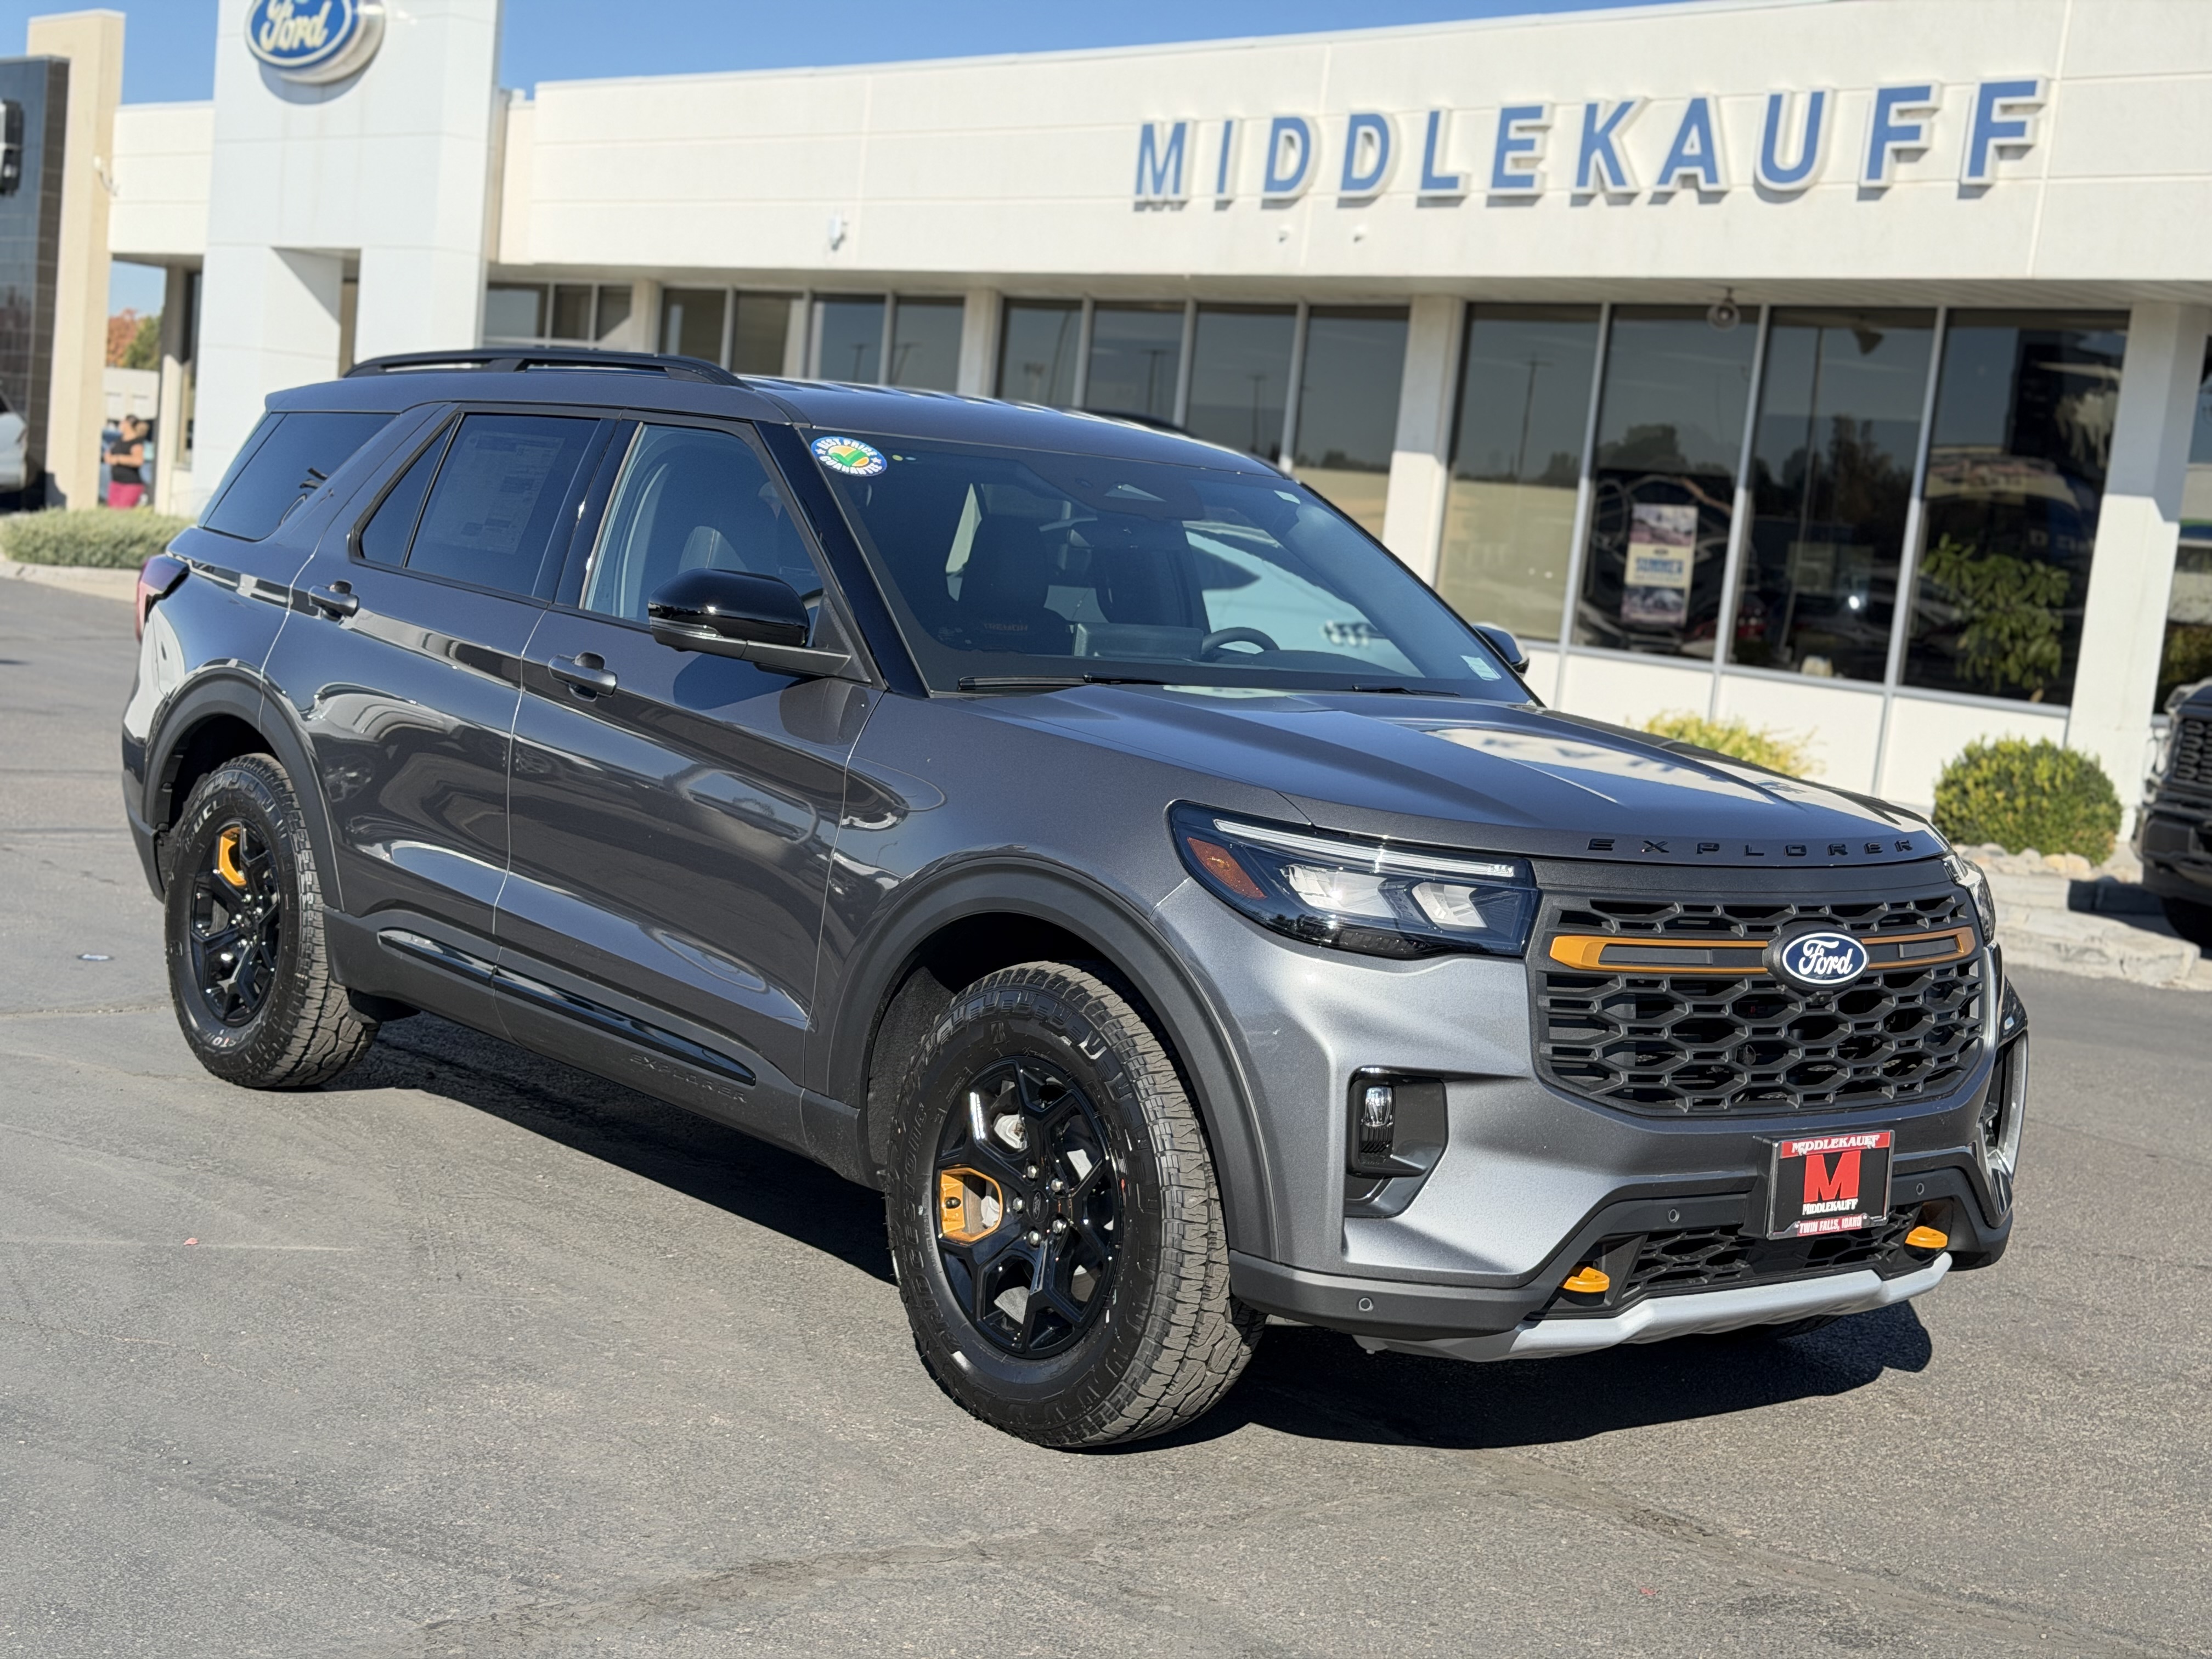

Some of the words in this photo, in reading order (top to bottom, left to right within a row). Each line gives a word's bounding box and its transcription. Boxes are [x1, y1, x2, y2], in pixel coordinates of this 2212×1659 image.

[259, 0, 332, 52] Ford
[1133, 78, 2046, 206] MIDDLEKAUFF
[816, 438, 842, 449] BEST
[843, 439, 877, 456] PRICE
[819, 455, 883, 475] GUARANTEE
[1587, 838, 1915, 856] EXPLORER
[1798, 939, 1853, 975] Ford
[630, 1054, 747, 1103] EXPLORER
[1791, 1134, 1880, 1154] MIDDLEKAUFF
[1804, 1150, 1861, 1203] M
[1802, 1198, 1858, 1216] MIDDLEKAUFF
[1799, 1222, 1818, 1234] TWIN
[1819, 1218, 1840, 1231] FALLS,
[1842, 1216, 1863, 1228] IDAHO
